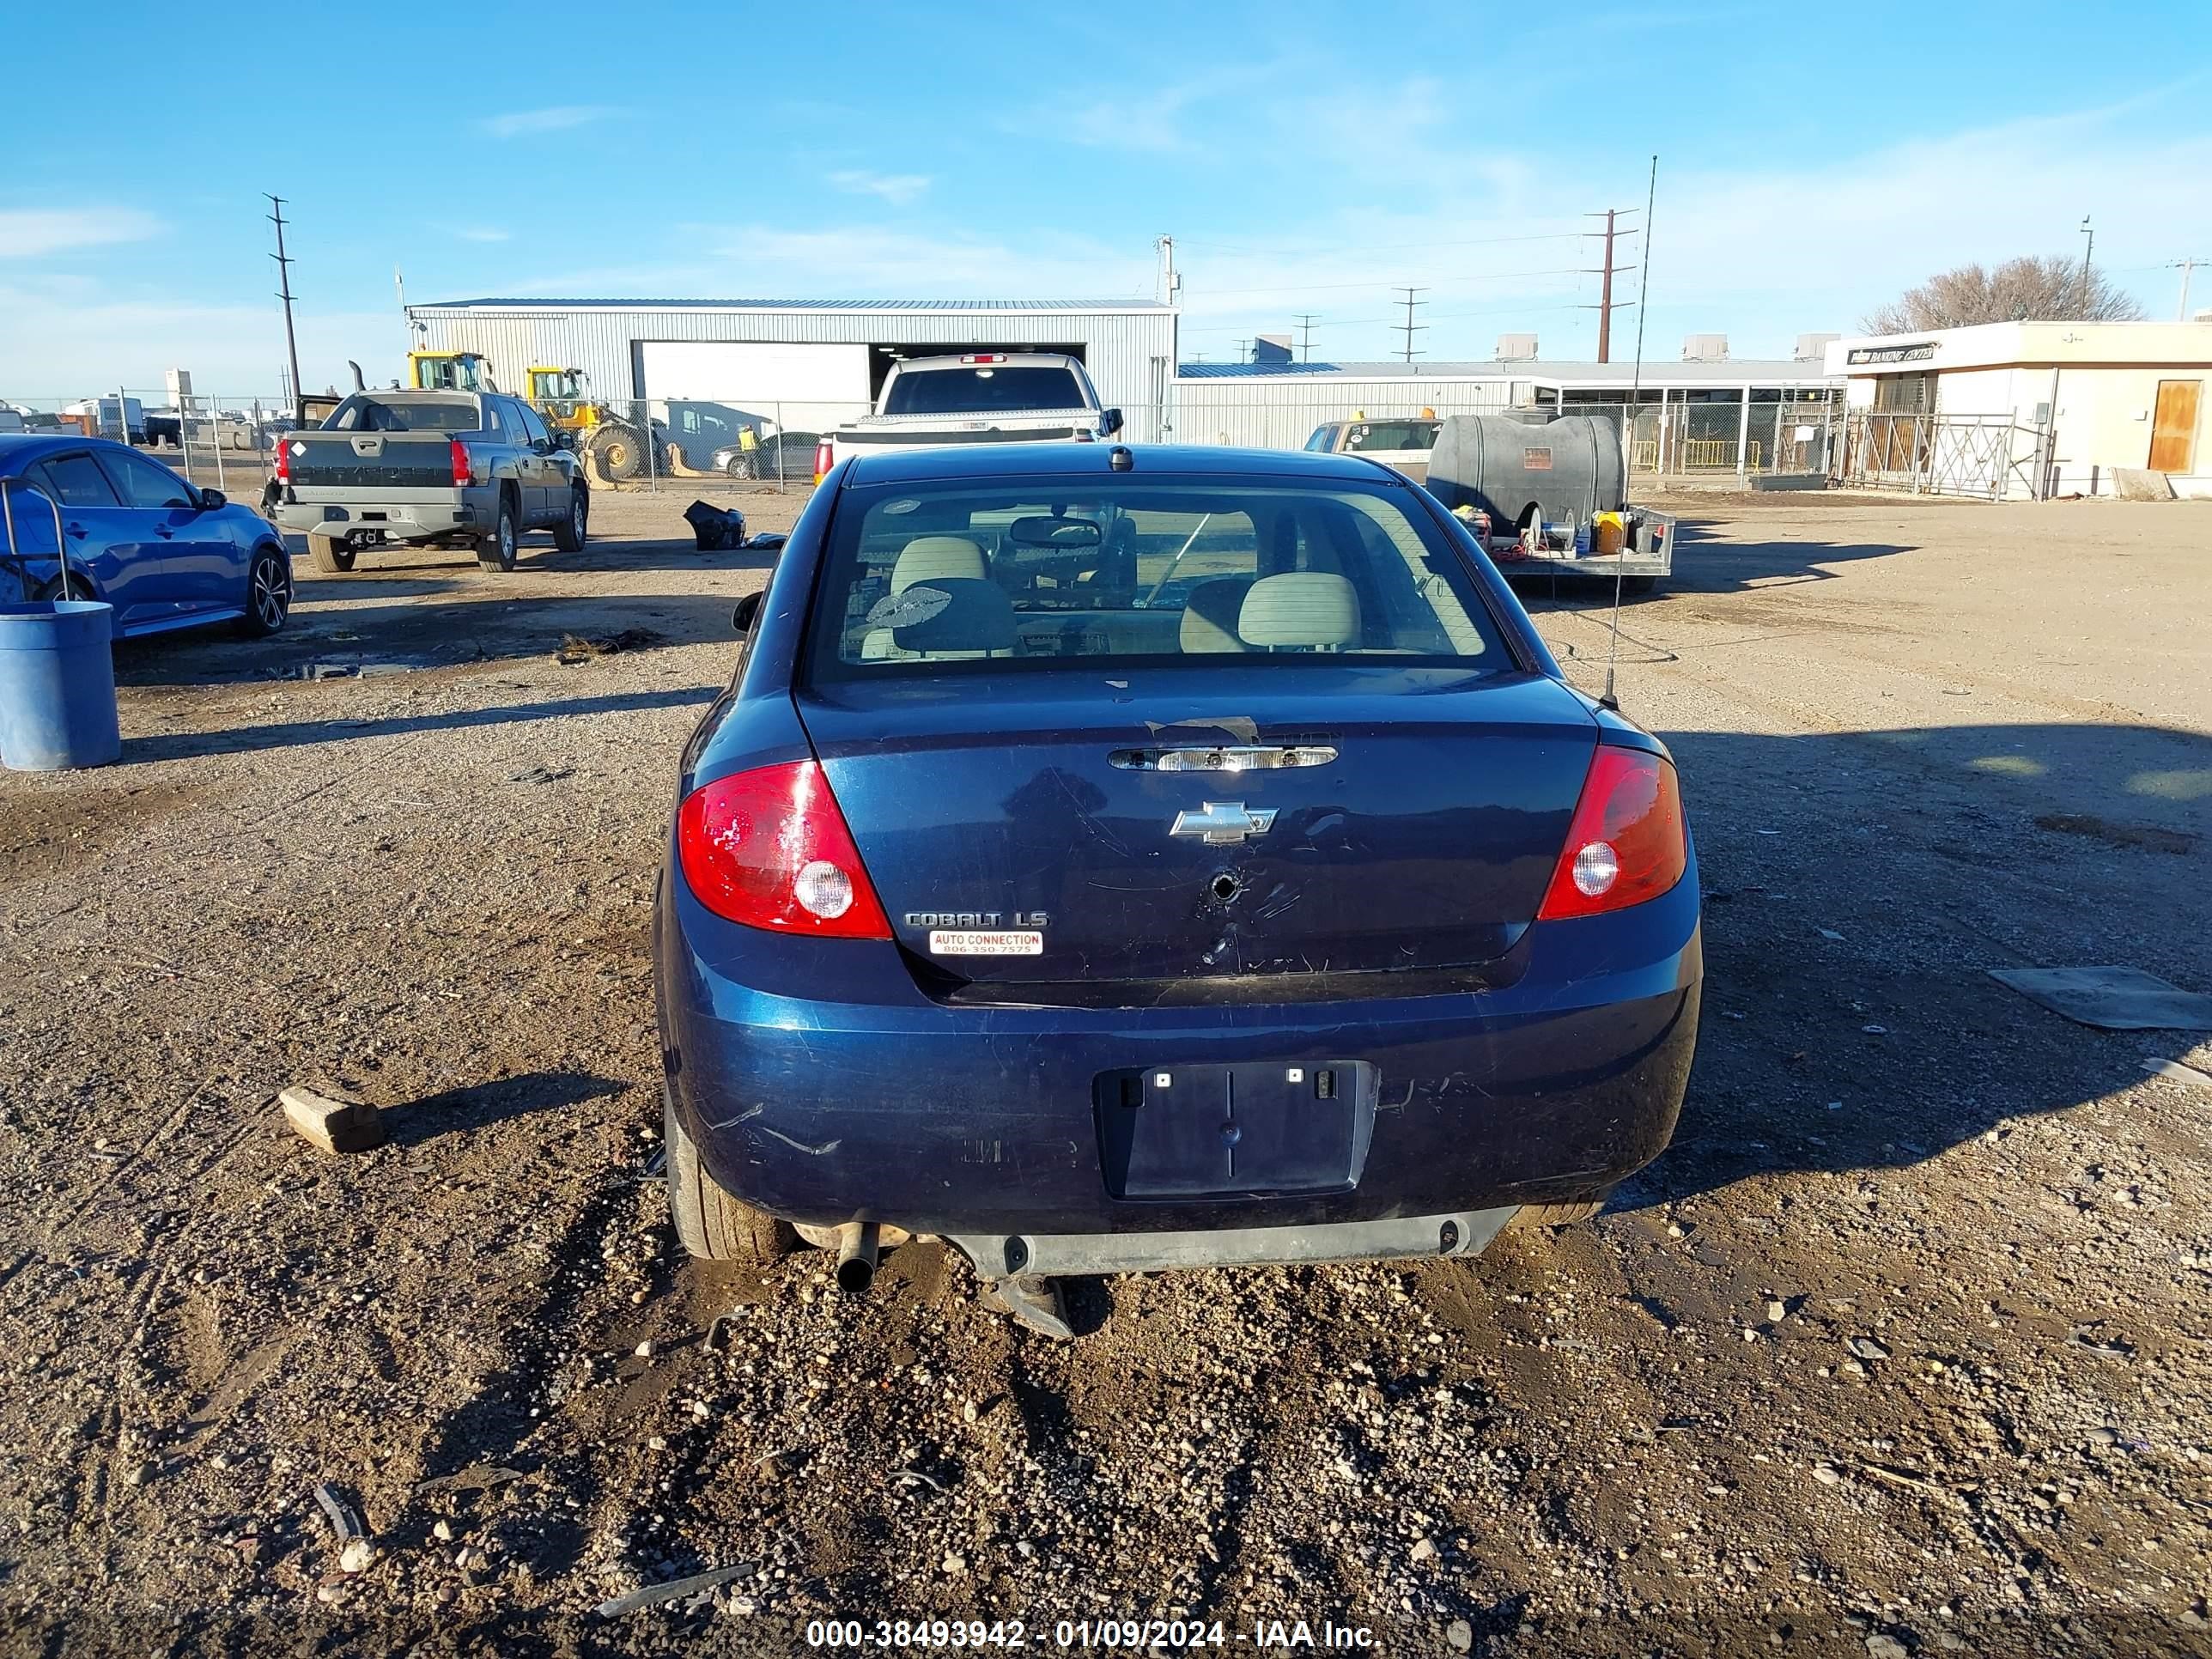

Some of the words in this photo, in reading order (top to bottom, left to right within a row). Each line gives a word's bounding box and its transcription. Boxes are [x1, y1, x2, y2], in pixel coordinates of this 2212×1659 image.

[1869, 351, 1905, 362] BANKING
[1904, 347, 1933, 360] CENTER
[904, 913, 1003, 927] COBALT
[1016, 913, 1049, 927] LS
[935, 934, 965, 945] AUTO
[968, 934, 1040, 945] CONNECTION
